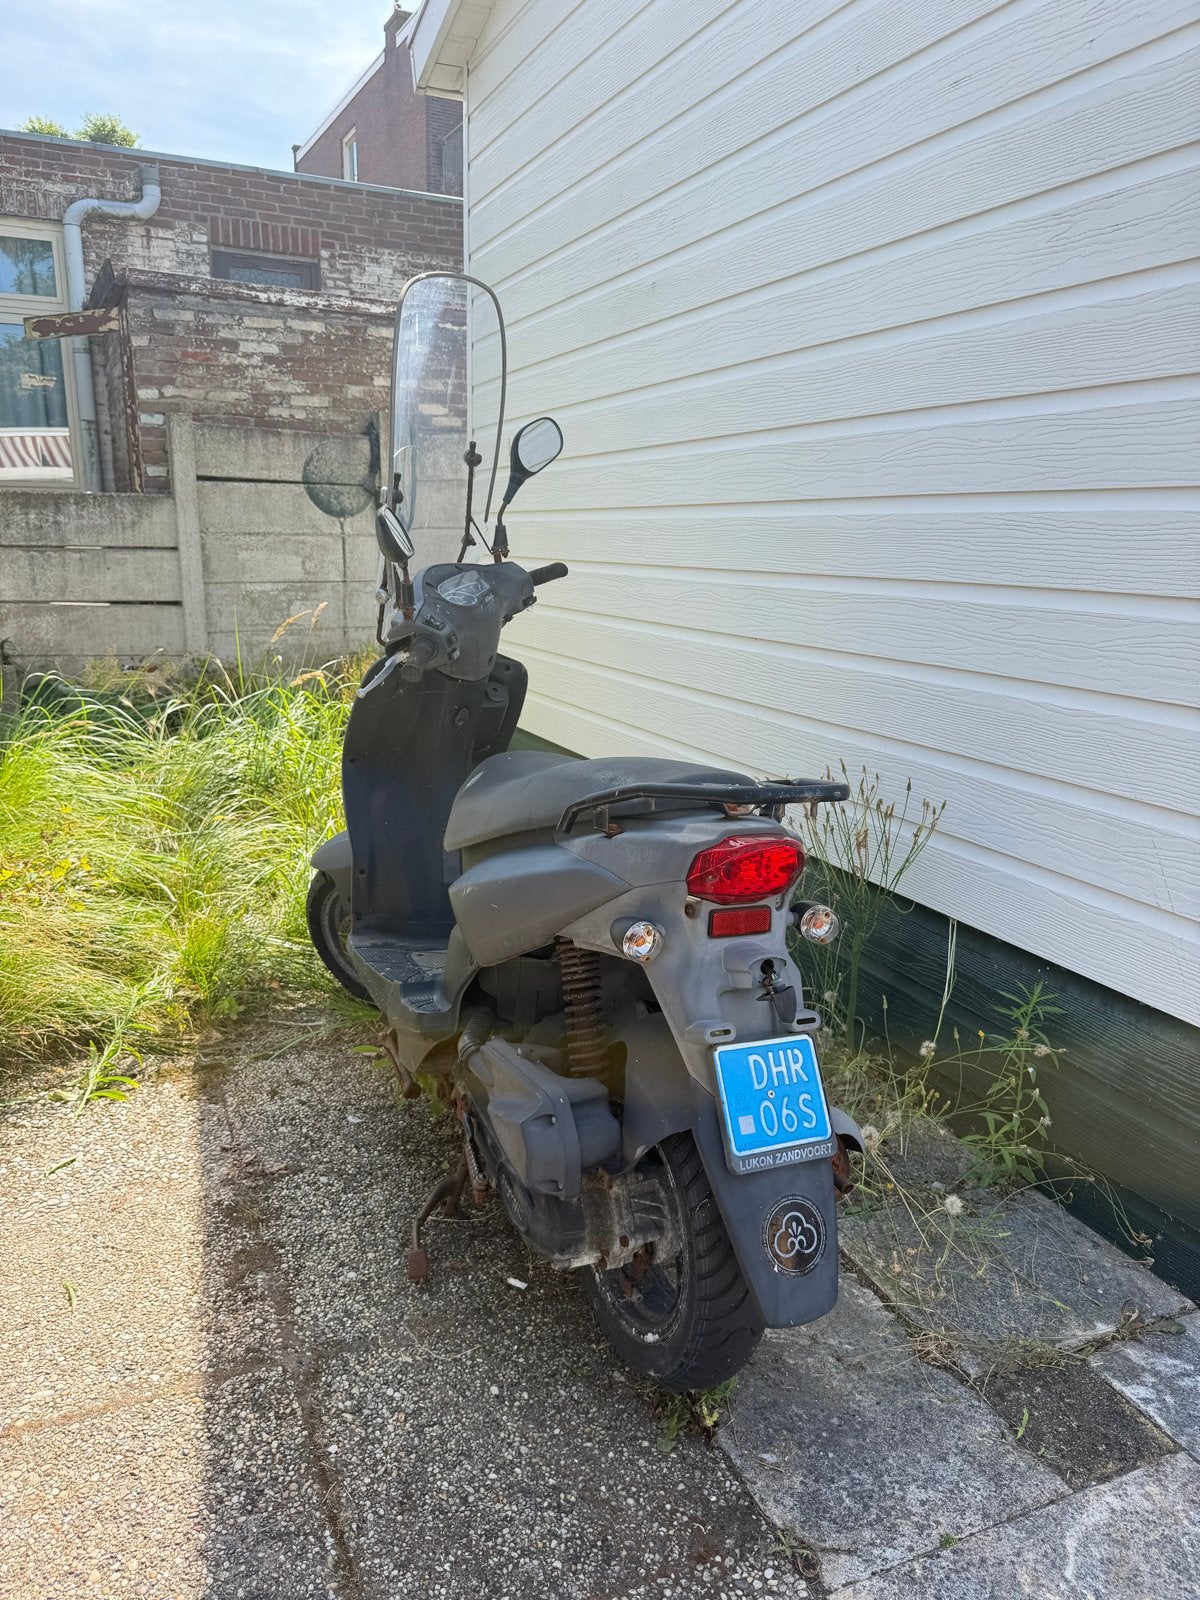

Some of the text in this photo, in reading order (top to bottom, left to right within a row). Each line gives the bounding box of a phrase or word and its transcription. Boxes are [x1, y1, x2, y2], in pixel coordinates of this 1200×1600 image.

[748, 1048, 808, 1090] DHR
[760, 1093, 817, 1137] 06S
[739, 1154, 774, 1171] LUKON
[775, 1142, 833, 1164] ZANDVOORT
